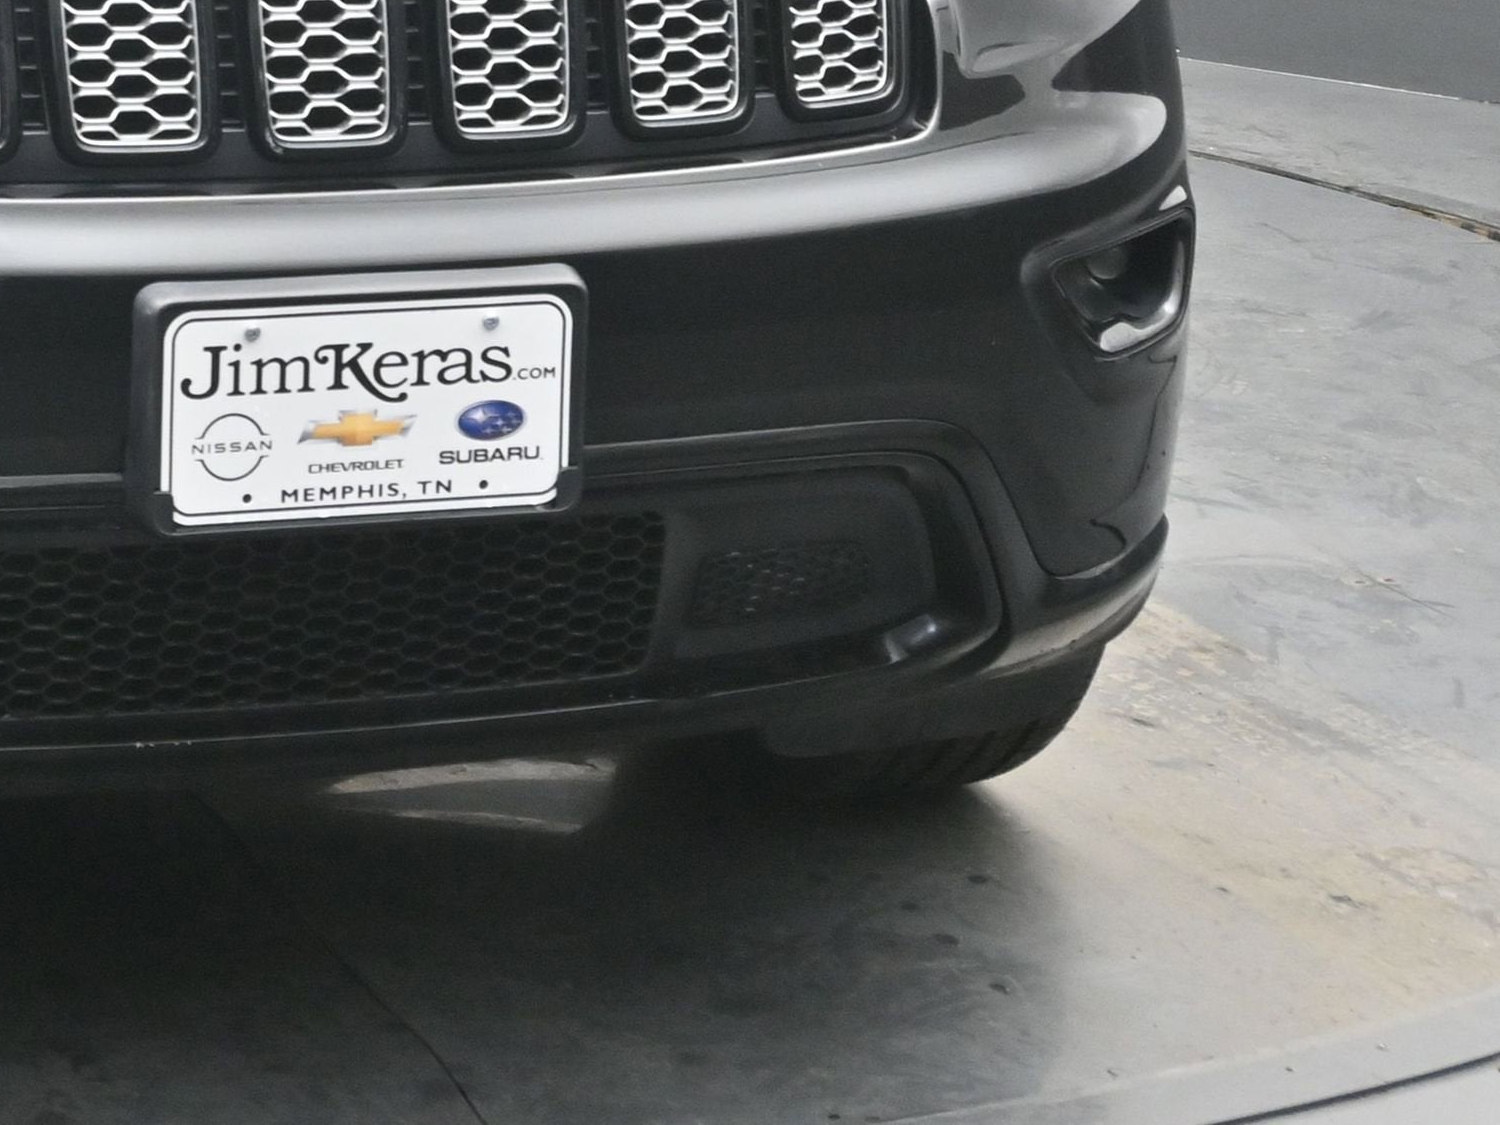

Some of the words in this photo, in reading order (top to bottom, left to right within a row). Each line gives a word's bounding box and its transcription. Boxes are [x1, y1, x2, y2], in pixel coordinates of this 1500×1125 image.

[192, 439, 273, 455] NISSAN
[438, 446, 542, 466] SUBARU
[308, 458, 405, 475] CHEVROLET
[281, 482, 407, 504] MEMPHIS,
[418, 479, 453, 496] TN
